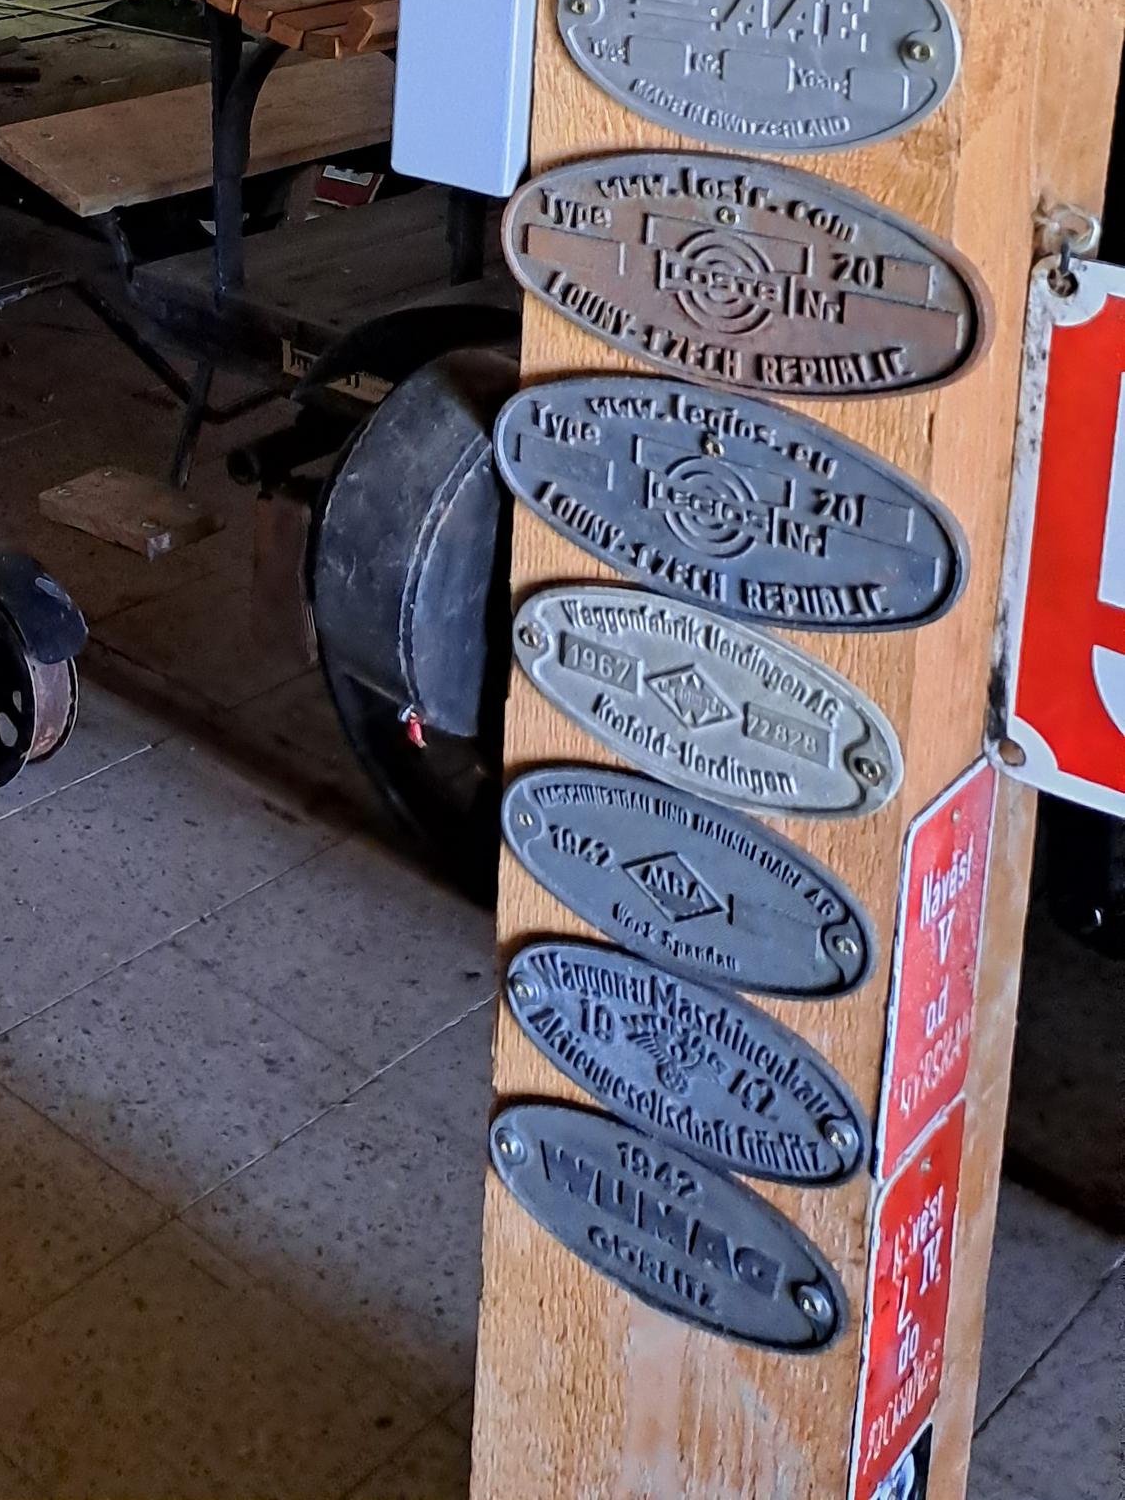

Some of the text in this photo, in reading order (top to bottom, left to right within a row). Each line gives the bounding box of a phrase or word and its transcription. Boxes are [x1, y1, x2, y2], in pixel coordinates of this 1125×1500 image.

[757, 347, 916, 387] REPUBLIC
[741, 577, 894, 618] REPUBLIC
[562, 599, 704, 650] Waggonfabrik
[703, 624, 815, 704] Uerdingen
[569, 642, 632, 683] 1967
